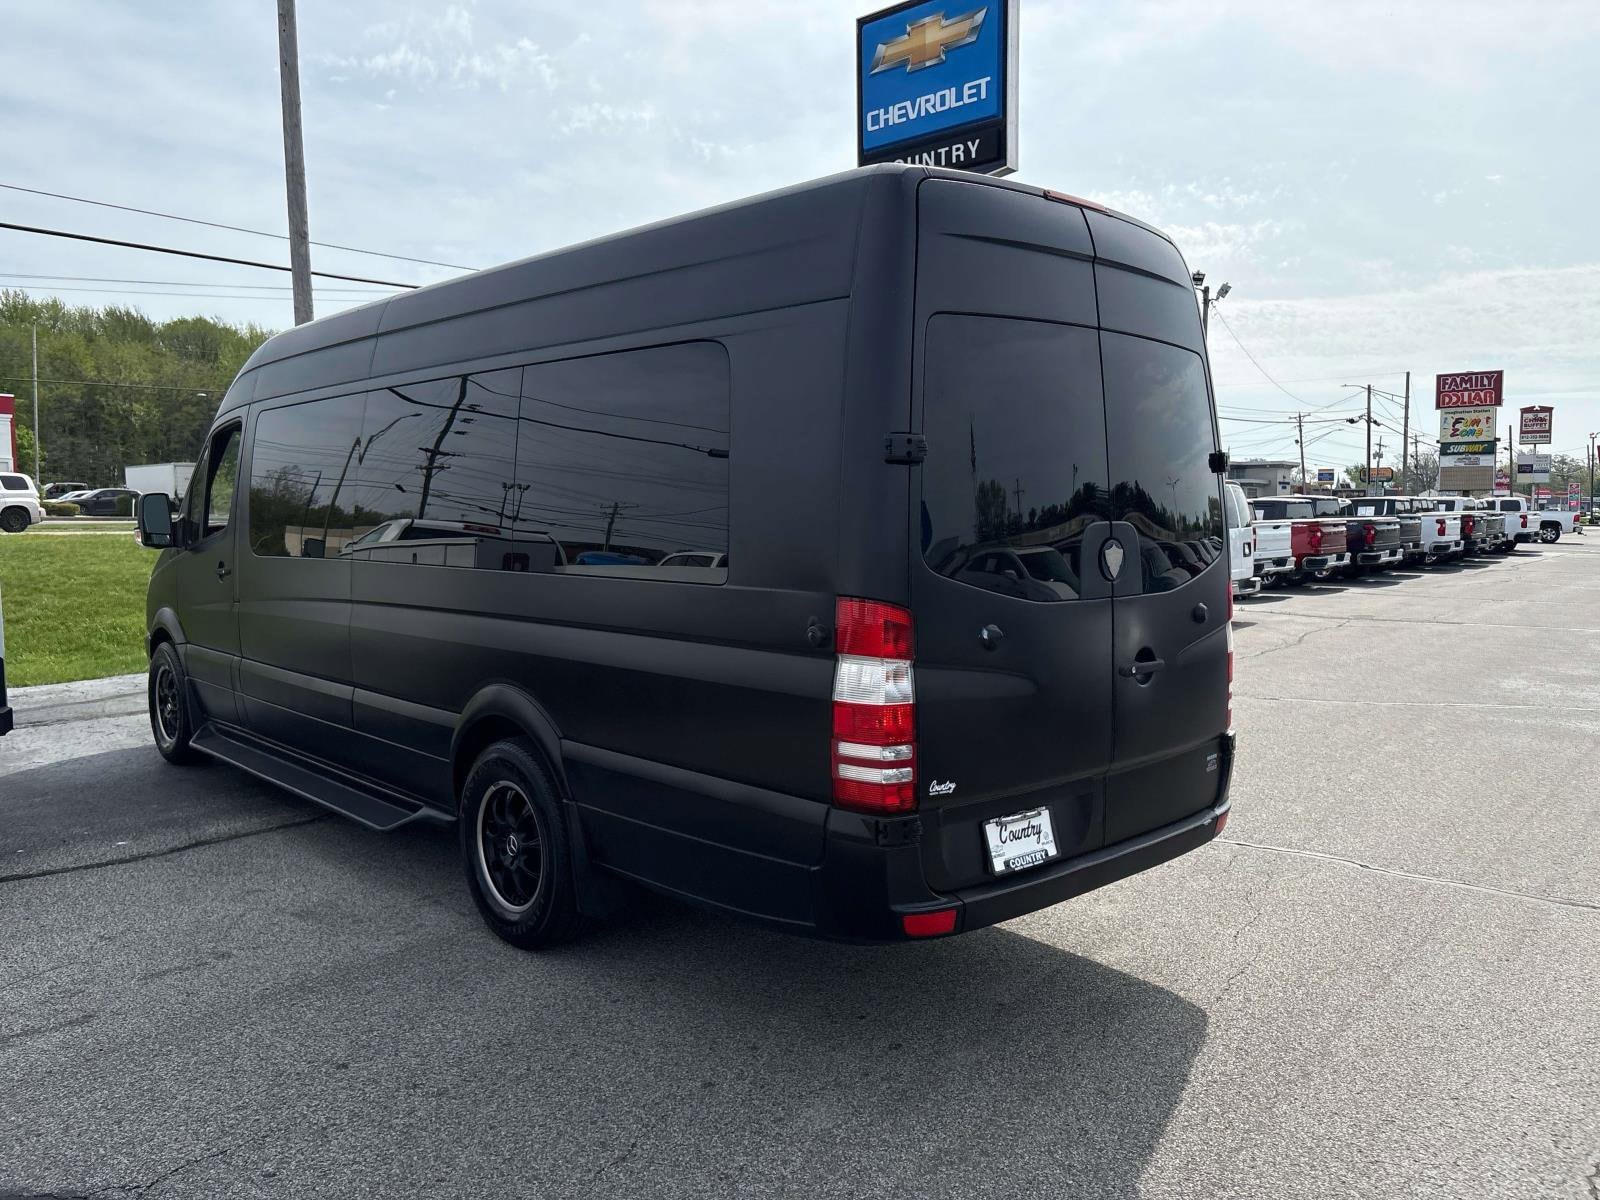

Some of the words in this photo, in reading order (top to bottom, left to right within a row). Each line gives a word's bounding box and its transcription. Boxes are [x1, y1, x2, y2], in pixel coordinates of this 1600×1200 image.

[866, 76, 991, 132] CHEVROLET
[894, 138, 980, 167] UNTRY
[1440, 374, 1497, 391] FAMILY
[1440, 389, 1495, 407] DOLLAR
[1447, 443, 1488, 453] SUBWAY
[999, 820, 1042, 844] Country
[1009, 850, 1046, 868] COUNTRY
